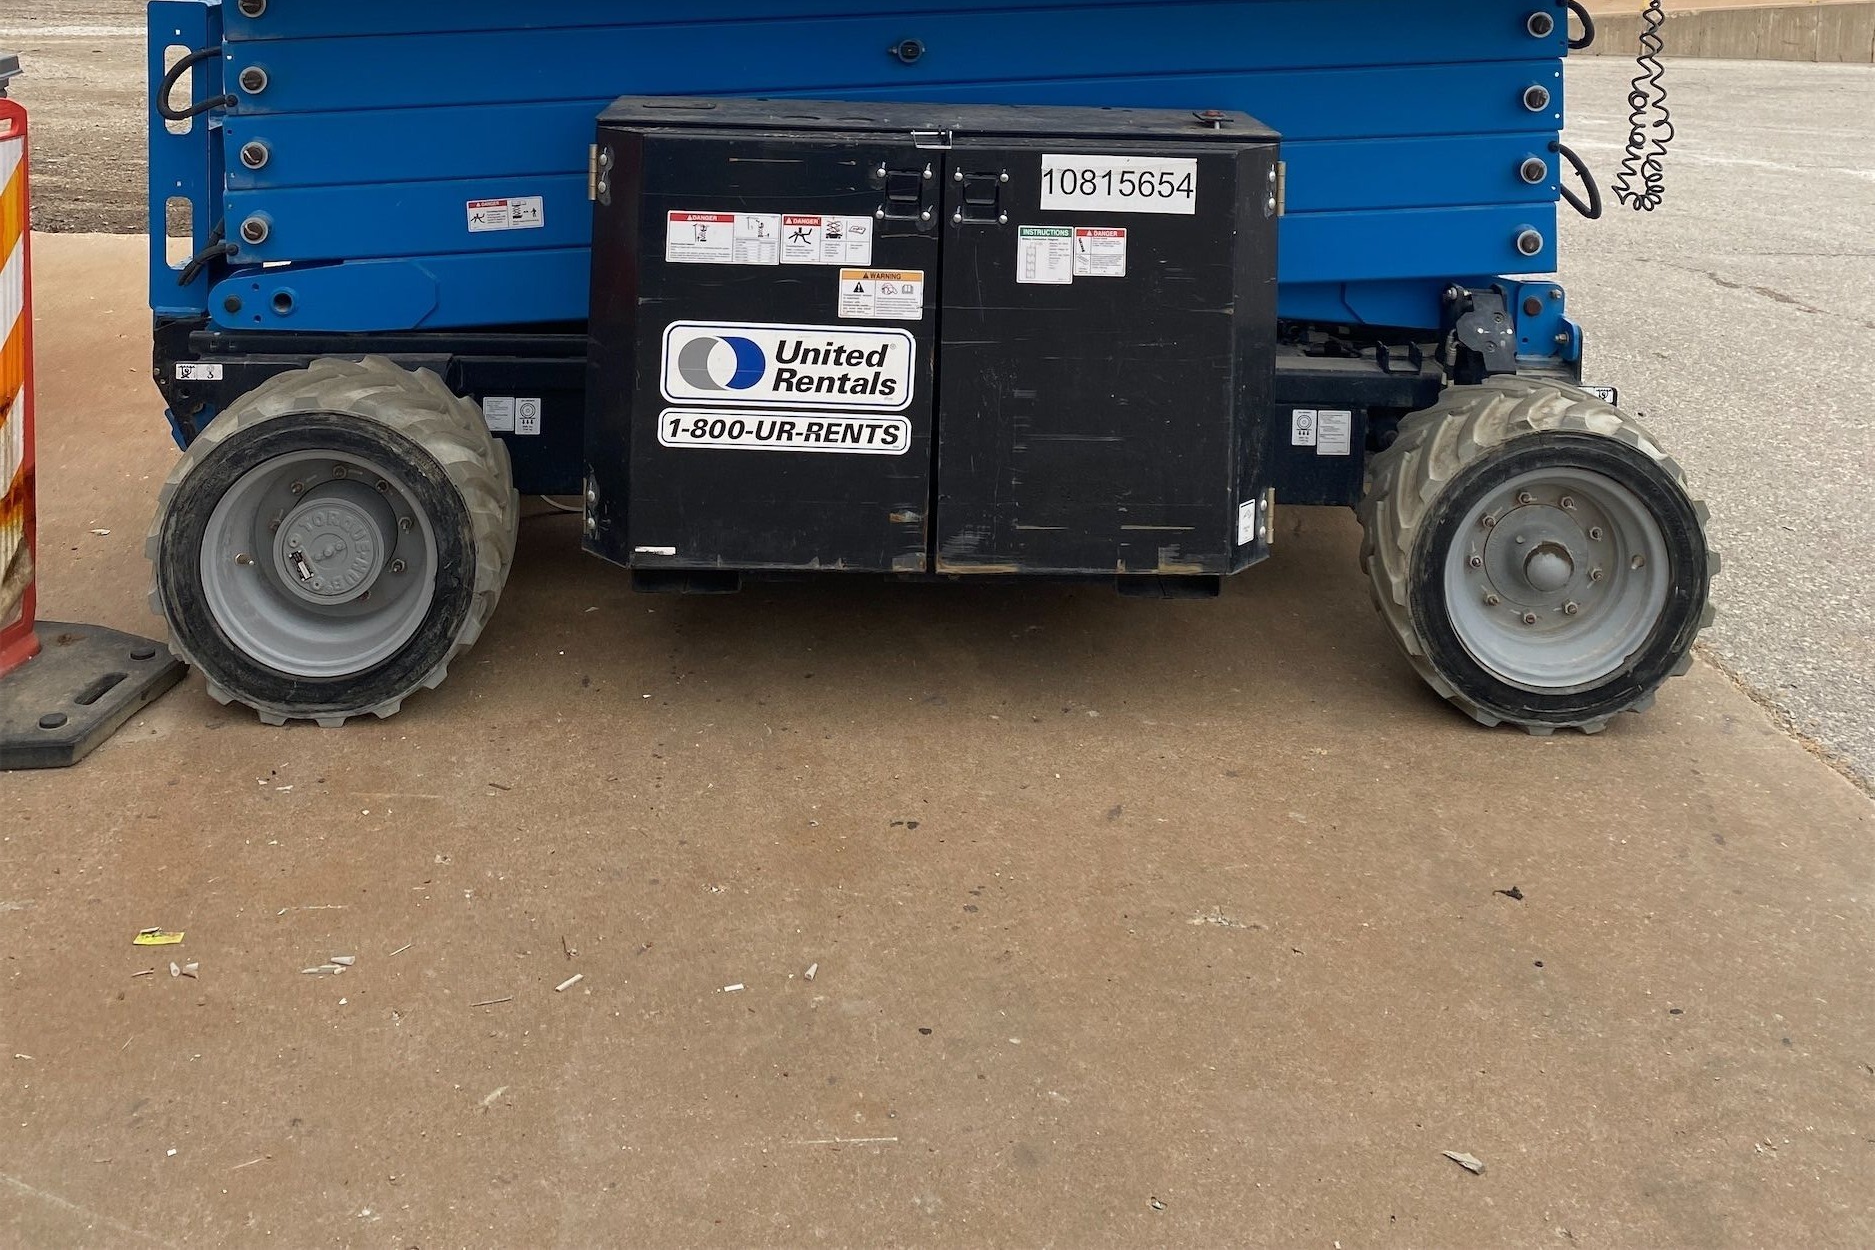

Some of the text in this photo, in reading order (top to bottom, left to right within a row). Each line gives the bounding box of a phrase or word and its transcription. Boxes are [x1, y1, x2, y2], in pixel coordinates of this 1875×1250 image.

[1043, 168, 1194, 199] 10815654
[793, 217, 819, 225] DANGER
[1023, 228, 1070, 237] INSTRUCTIONS
[775, 340, 889, 368] United
[772, 367, 897, 396] Rentals
[669, 418, 900, 445] 1-800-UR-RENTS
